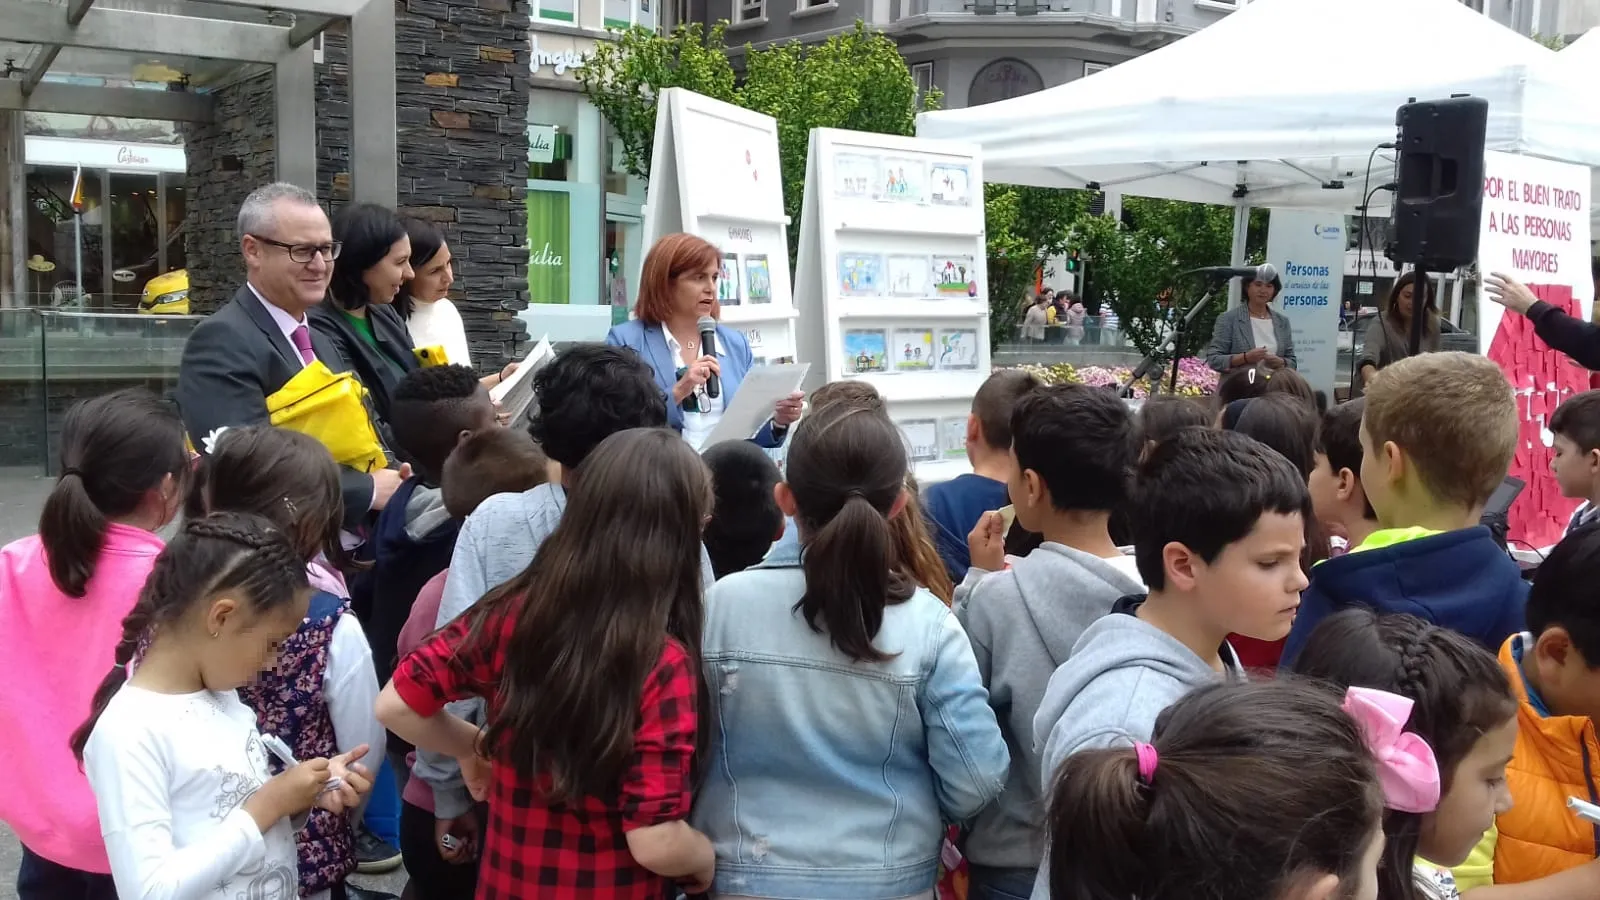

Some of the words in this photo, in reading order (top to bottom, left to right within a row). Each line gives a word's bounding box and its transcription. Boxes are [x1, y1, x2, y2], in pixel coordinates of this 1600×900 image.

[529, 133, 550, 150] ulia
[1483, 176, 1504, 199] POR
[1508, 180, 1519, 201] EL
[1523, 182, 1550, 206] BUEN
[1553, 187, 1581, 211] TRATO
[1489, 211, 1498, 233] A
[1501, 211, 1520, 236] LAS
[1524, 215, 1572, 242] PERSONAS
[527, 238, 563, 266] úlia
[1512, 247, 1558, 273] MAYORES
[1285, 261, 1329, 276] Personas
[1283, 295, 1328, 310] personas
